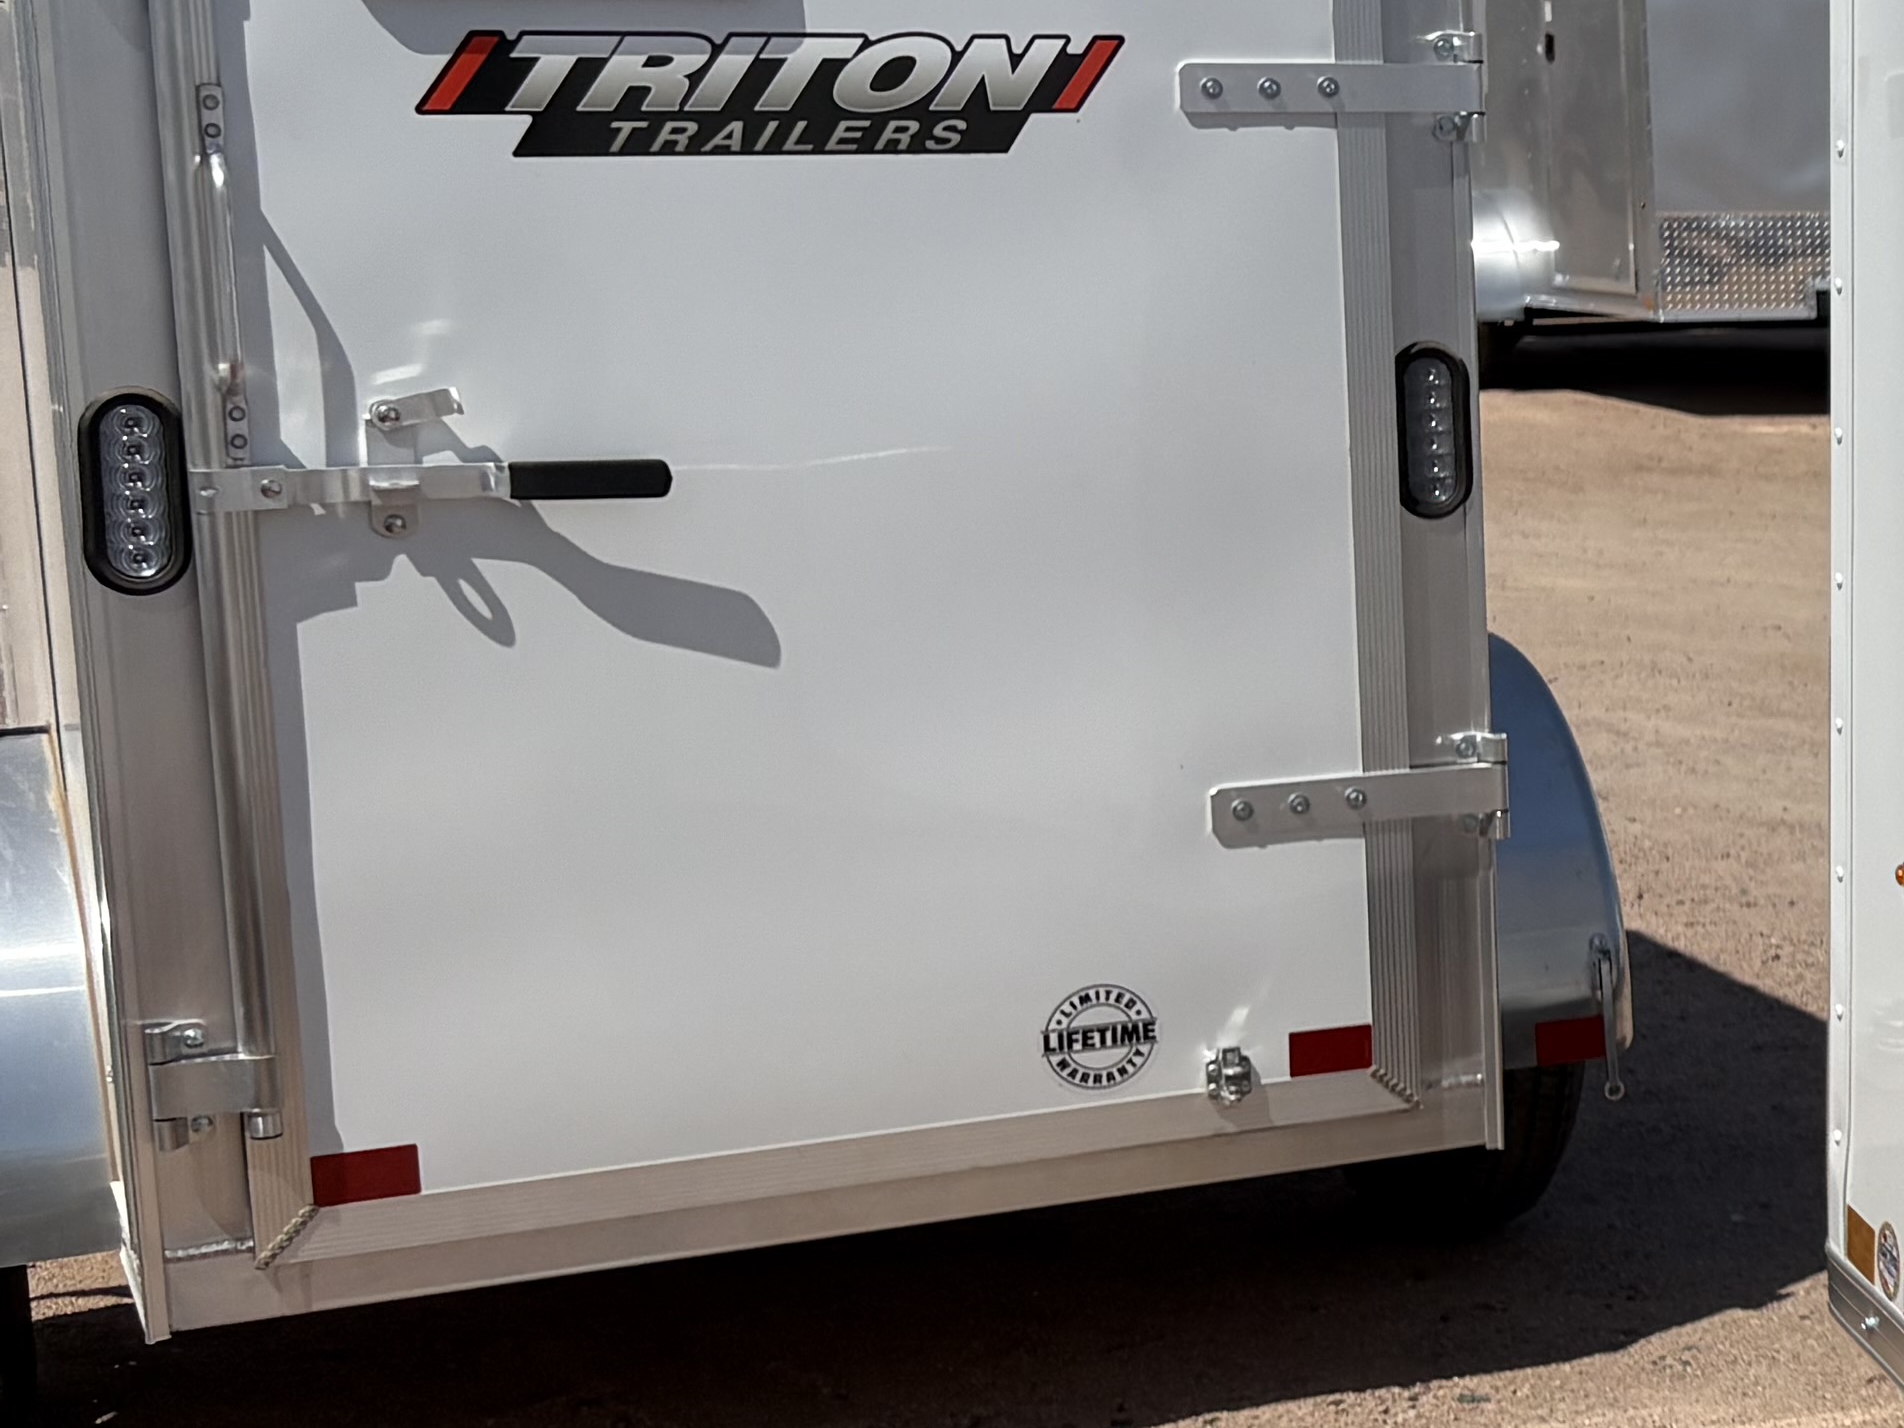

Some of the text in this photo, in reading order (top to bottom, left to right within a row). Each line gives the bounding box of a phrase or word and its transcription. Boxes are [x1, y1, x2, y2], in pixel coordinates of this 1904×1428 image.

[504, 33, 1071, 113] TRITON
[609, 118, 969, 155] TRAILERS
[1059, 989, 1138, 1019] LIMITED
[1043, 1020, 1157, 1054] LIFETIME
[1055, 1047, 1146, 1086] WARRANTY
